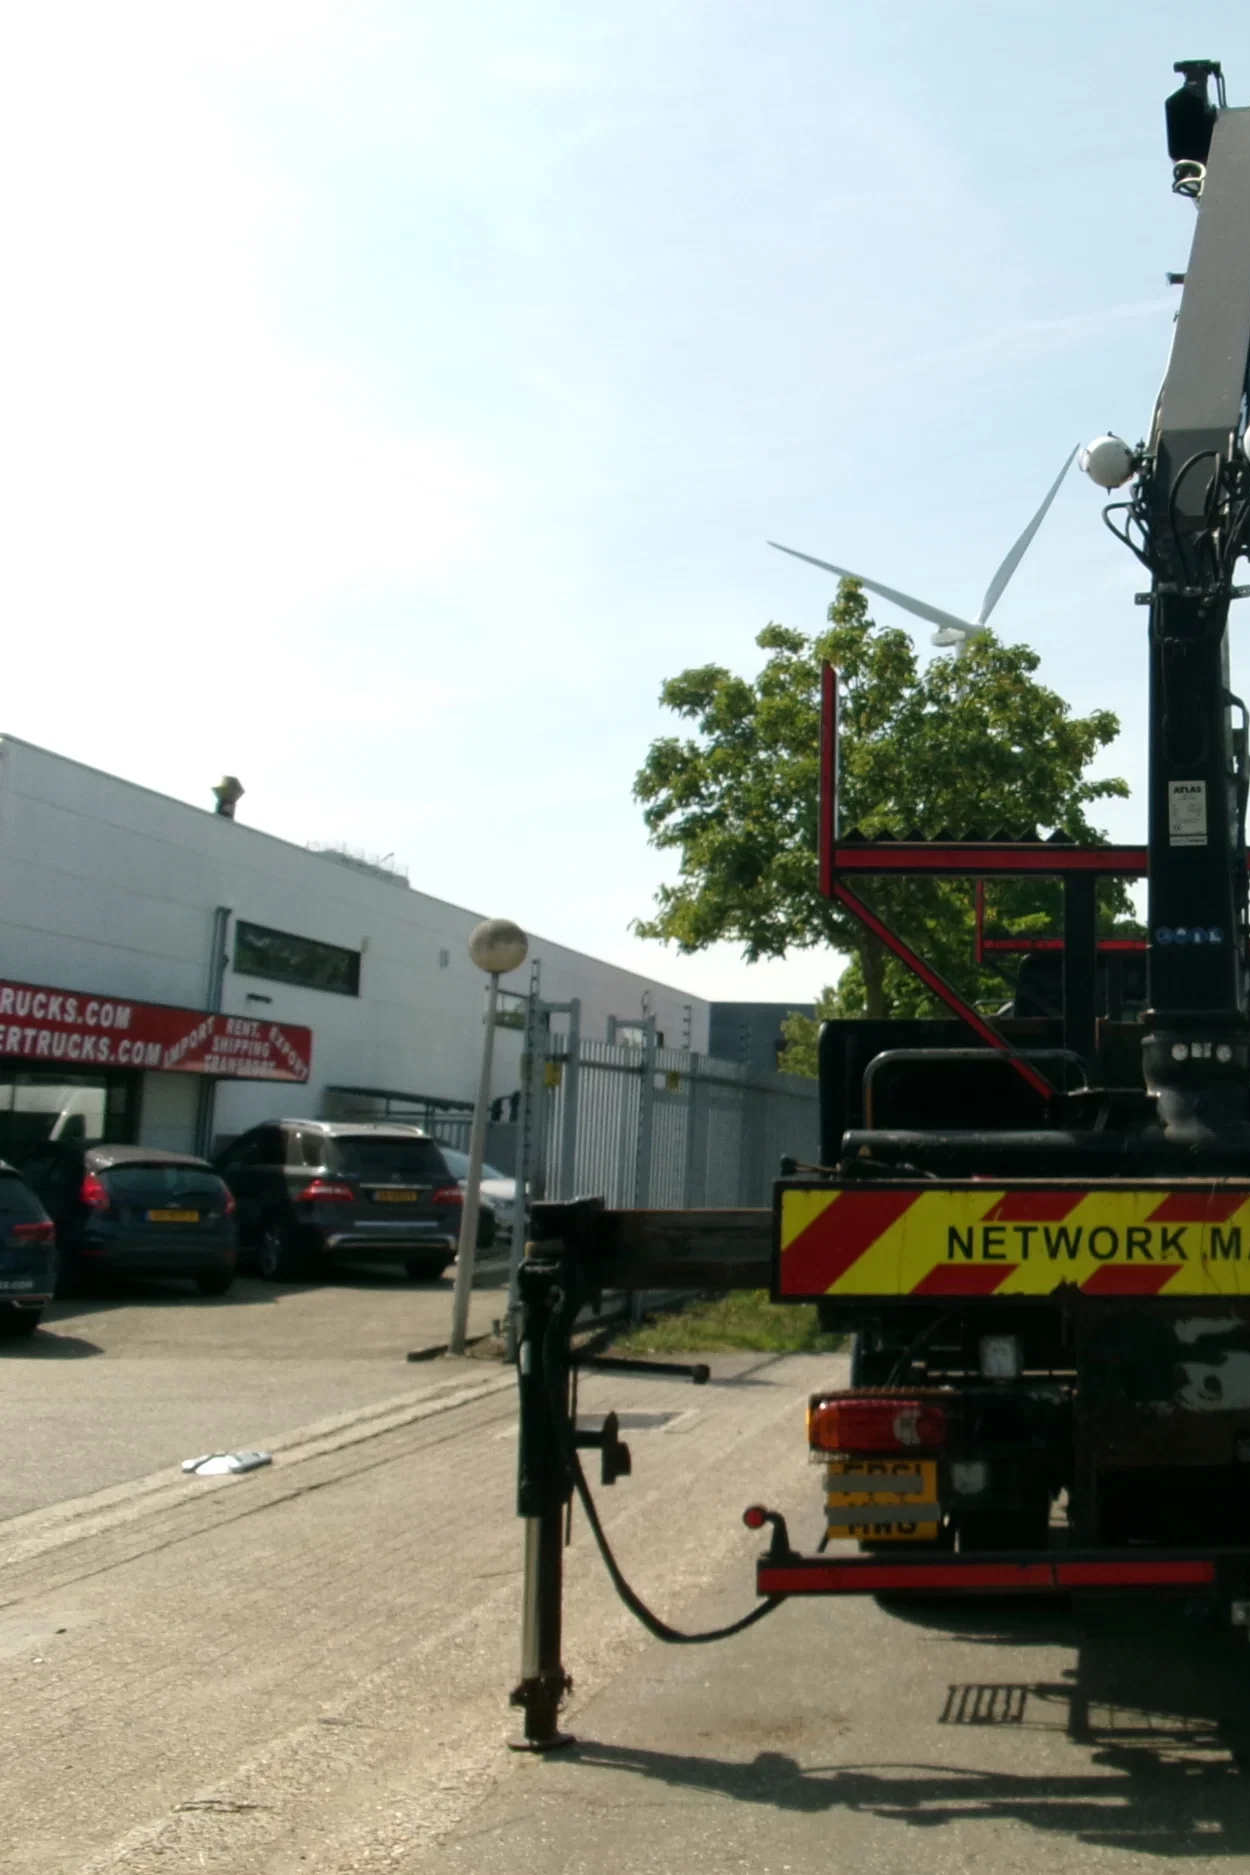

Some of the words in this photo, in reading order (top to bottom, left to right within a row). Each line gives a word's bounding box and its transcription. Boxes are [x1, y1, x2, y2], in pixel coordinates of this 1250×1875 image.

[1173, 786, 1202, 794] ATLAS
[0, 986, 132, 1030] RUCKS.COM
[164, 1015, 215, 1068] IMPORT
[212, 1035, 271, 1058] SHIPPING
[269, 1026, 309, 1079] EXPORT
[947, 1225, 1189, 1261] NETWORK
